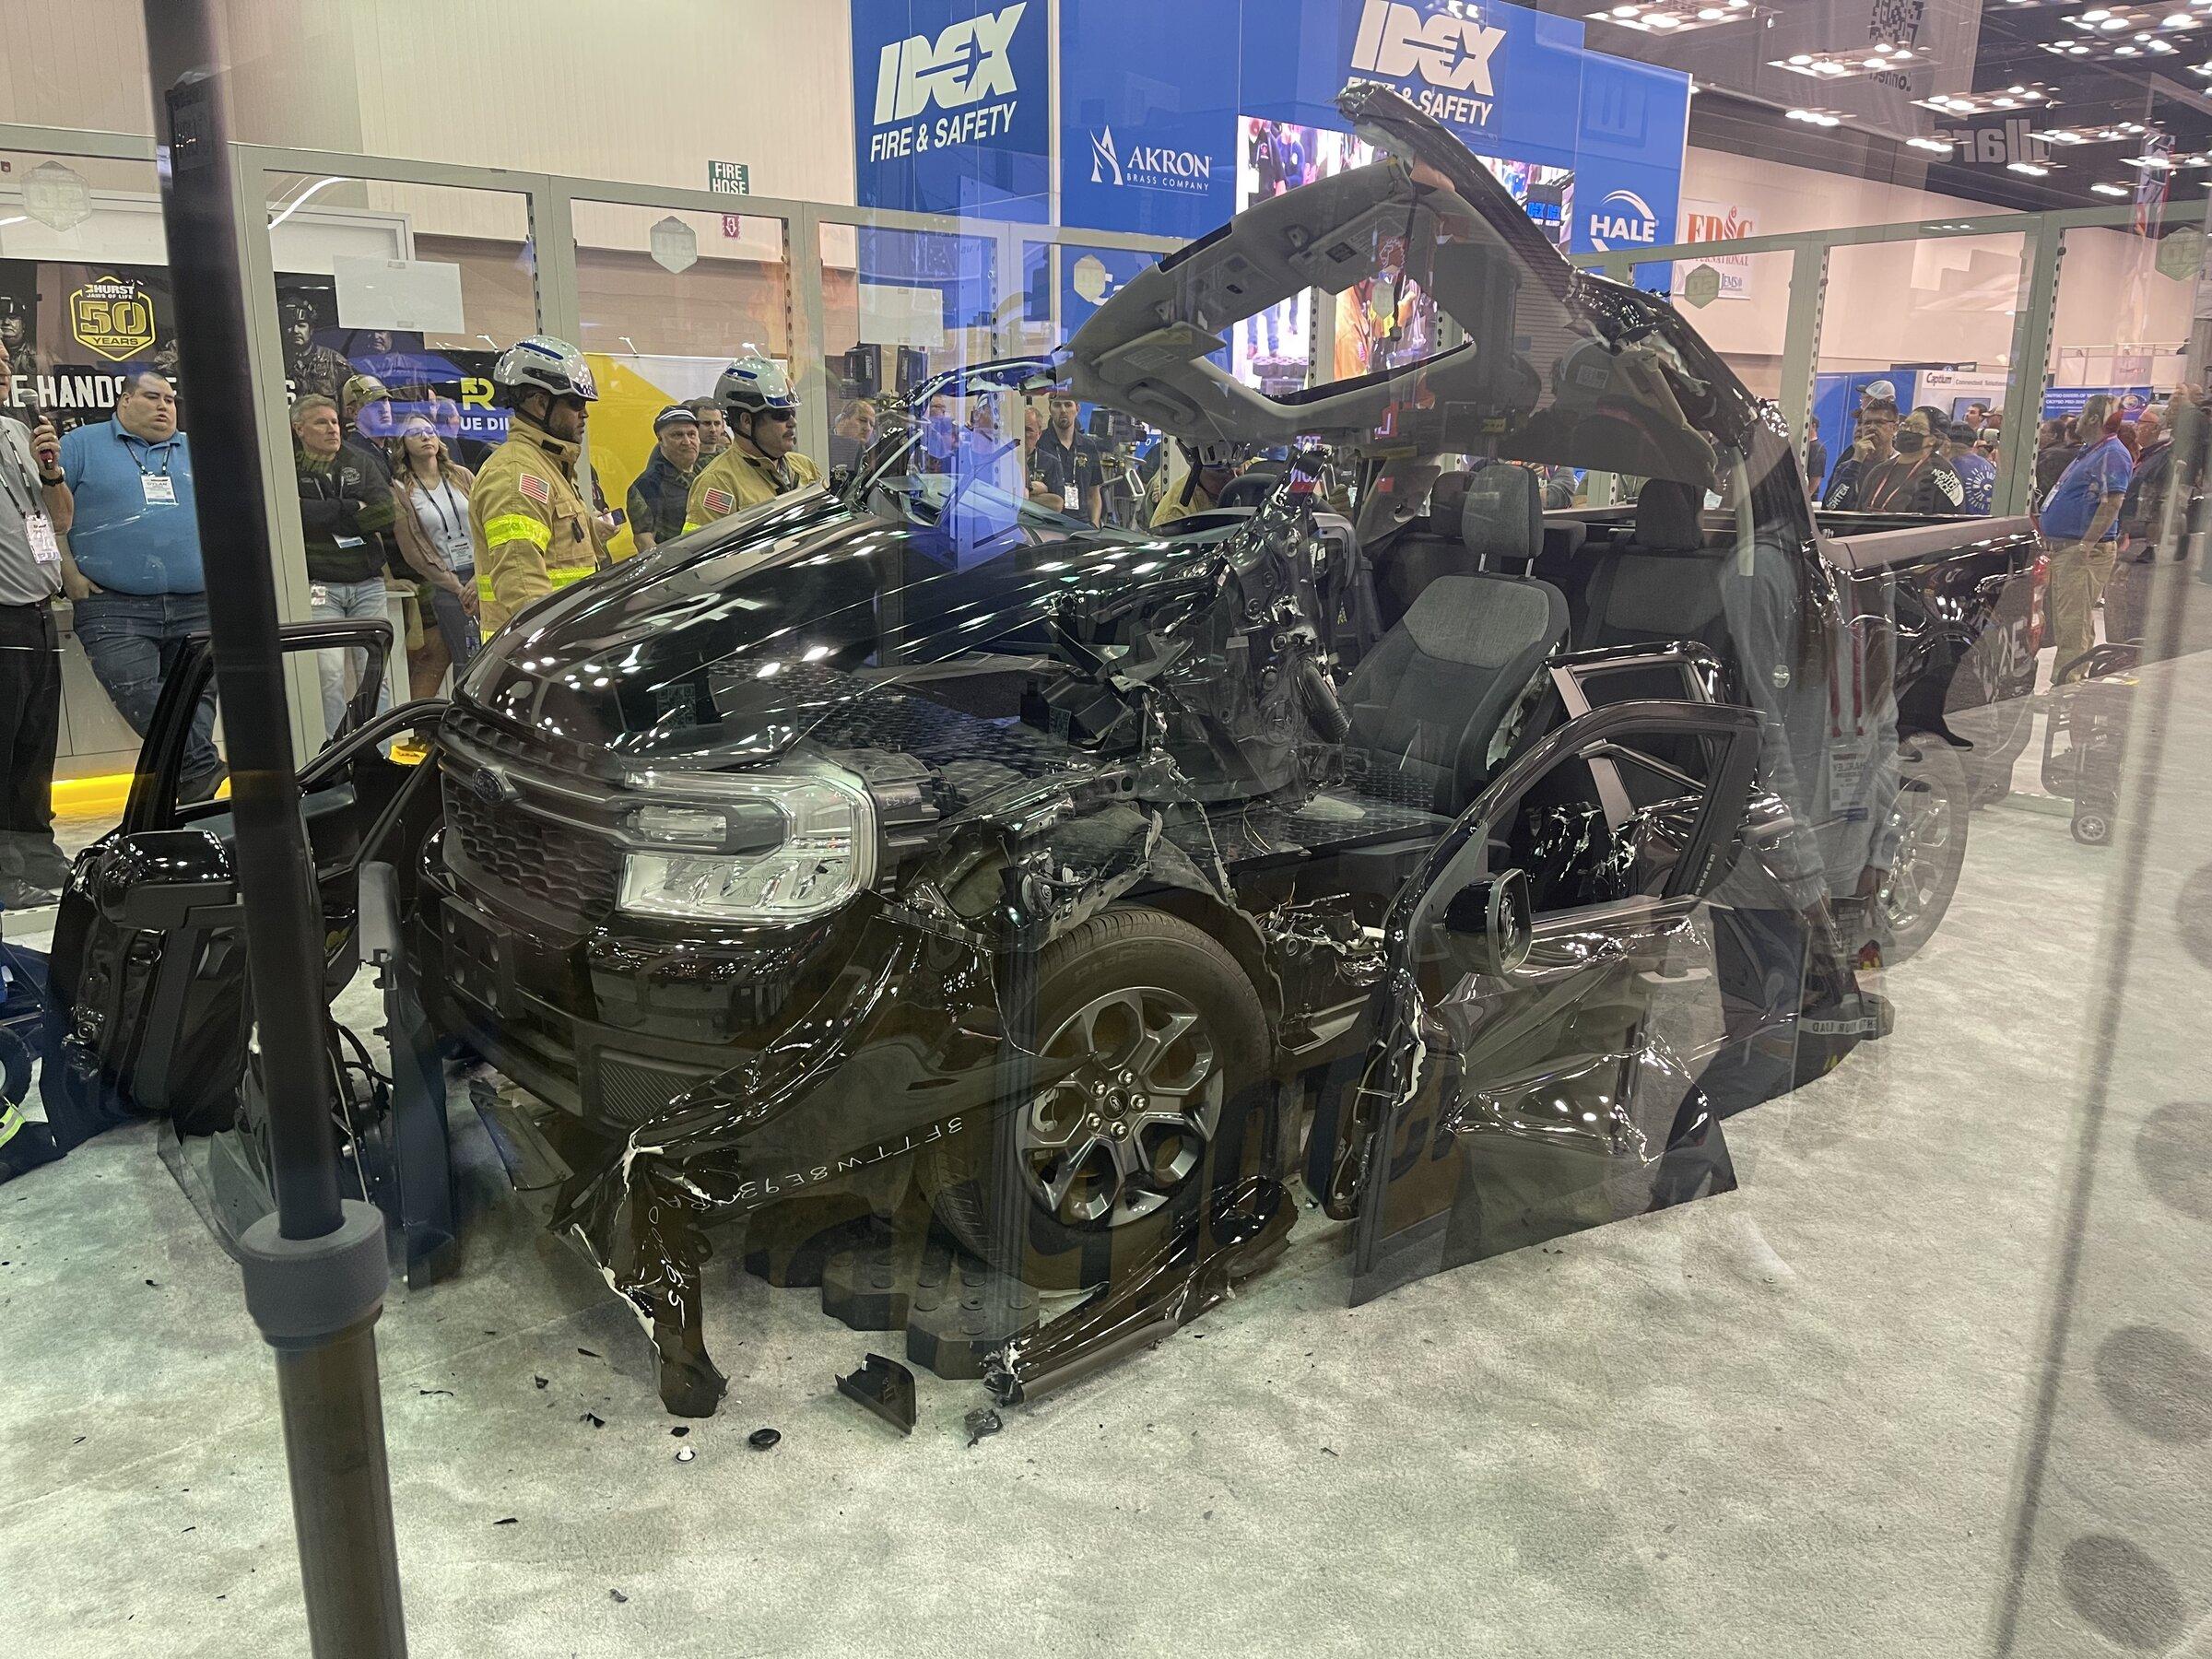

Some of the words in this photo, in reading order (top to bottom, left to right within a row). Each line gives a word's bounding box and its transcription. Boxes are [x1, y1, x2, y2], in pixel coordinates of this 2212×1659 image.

[1350, 0, 1507, 97] IDEX
[874, 2, 1028, 125] IDEX
[1418, 89, 1493, 126] SAFETY
[870, 126, 912, 162] FIRE
[916, 124, 929, 152] &
[934, 100, 1018, 148] SAFETY
[714, 162, 743, 180] FIRE
[1127, 146, 1212, 178] AKRON
[712, 178, 747, 195] HOSE
[1126, 172, 1157, 184] BRASS
[1162, 177, 1209, 191] COMPANY
[1590, 214, 1656, 242] HALE
[93, 284, 135, 294] HURST
[79, 300, 147, 335] 50
[92, 337, 138, 346] YEARS
[1931, 468, 1954, 490] NORTH
[1933, 476, 1953, 497] FACE
